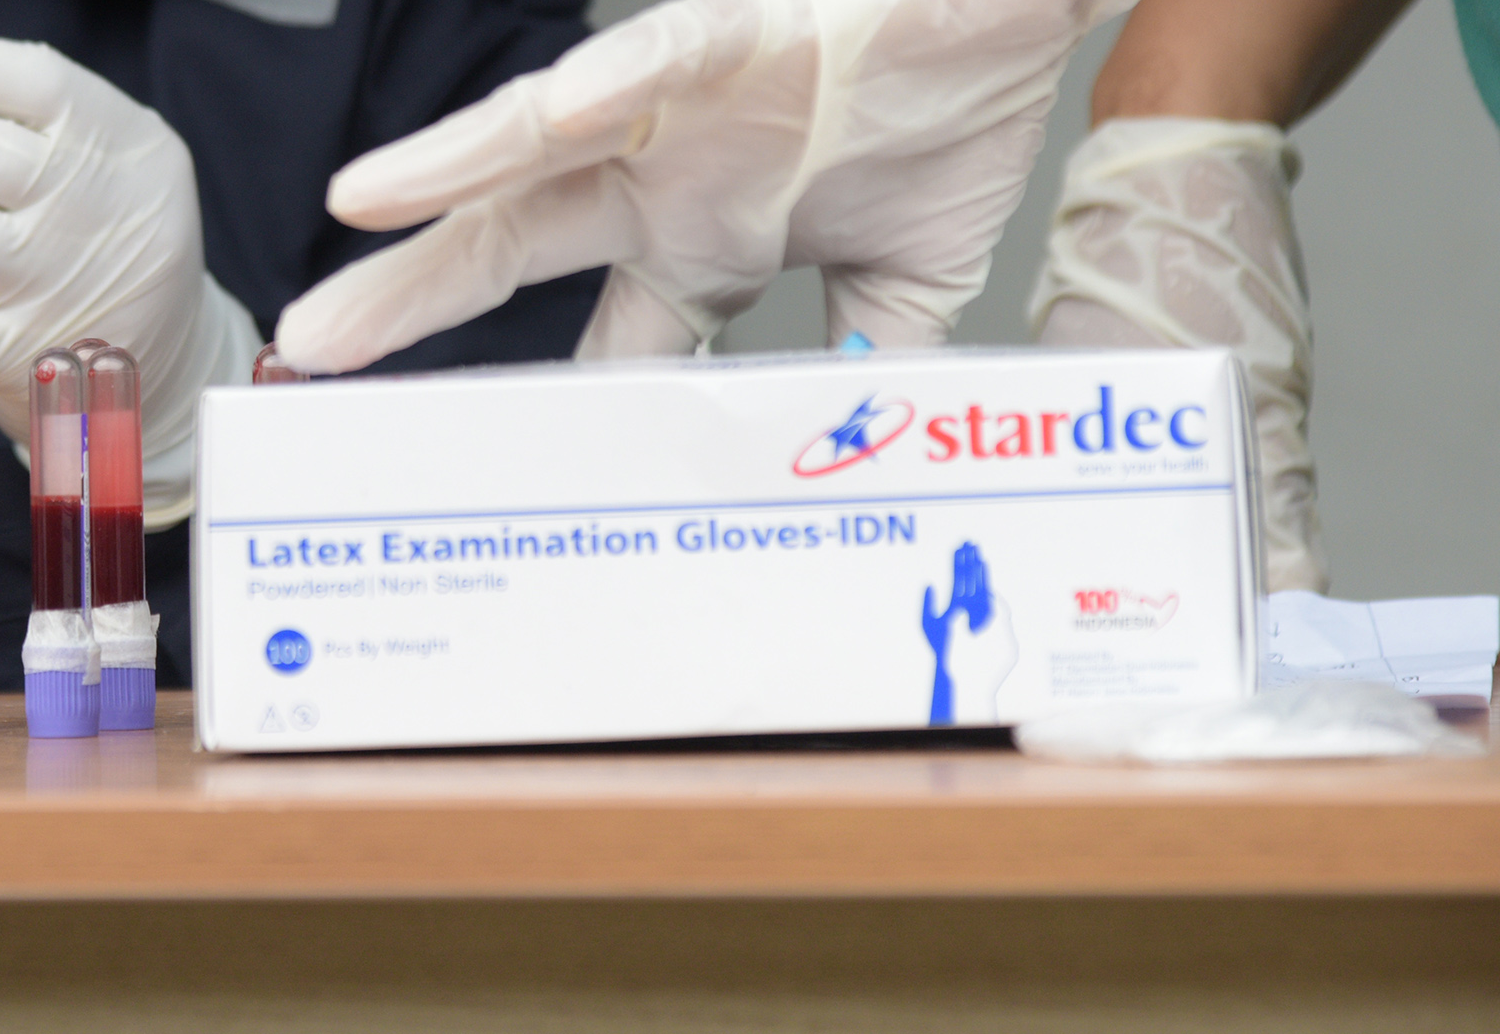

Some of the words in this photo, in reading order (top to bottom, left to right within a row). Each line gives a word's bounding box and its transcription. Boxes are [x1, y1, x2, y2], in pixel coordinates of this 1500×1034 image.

[925, 384, 1208, 463] stardec
[247, 536, 365, 568] Latex
[380, 523, 660, 565] Examination
[675, 513, 917, 554] Gloves-IDN
[247, 573, 366, 601] Powdered
[380, 573, 428, 597] Non
[434, 569, 509, 597] Sterile
[1074, 616, 1158, 633] INDONESIA
[266, 637, 312, 667] 100
[386, 635, 451, 660] Weight
